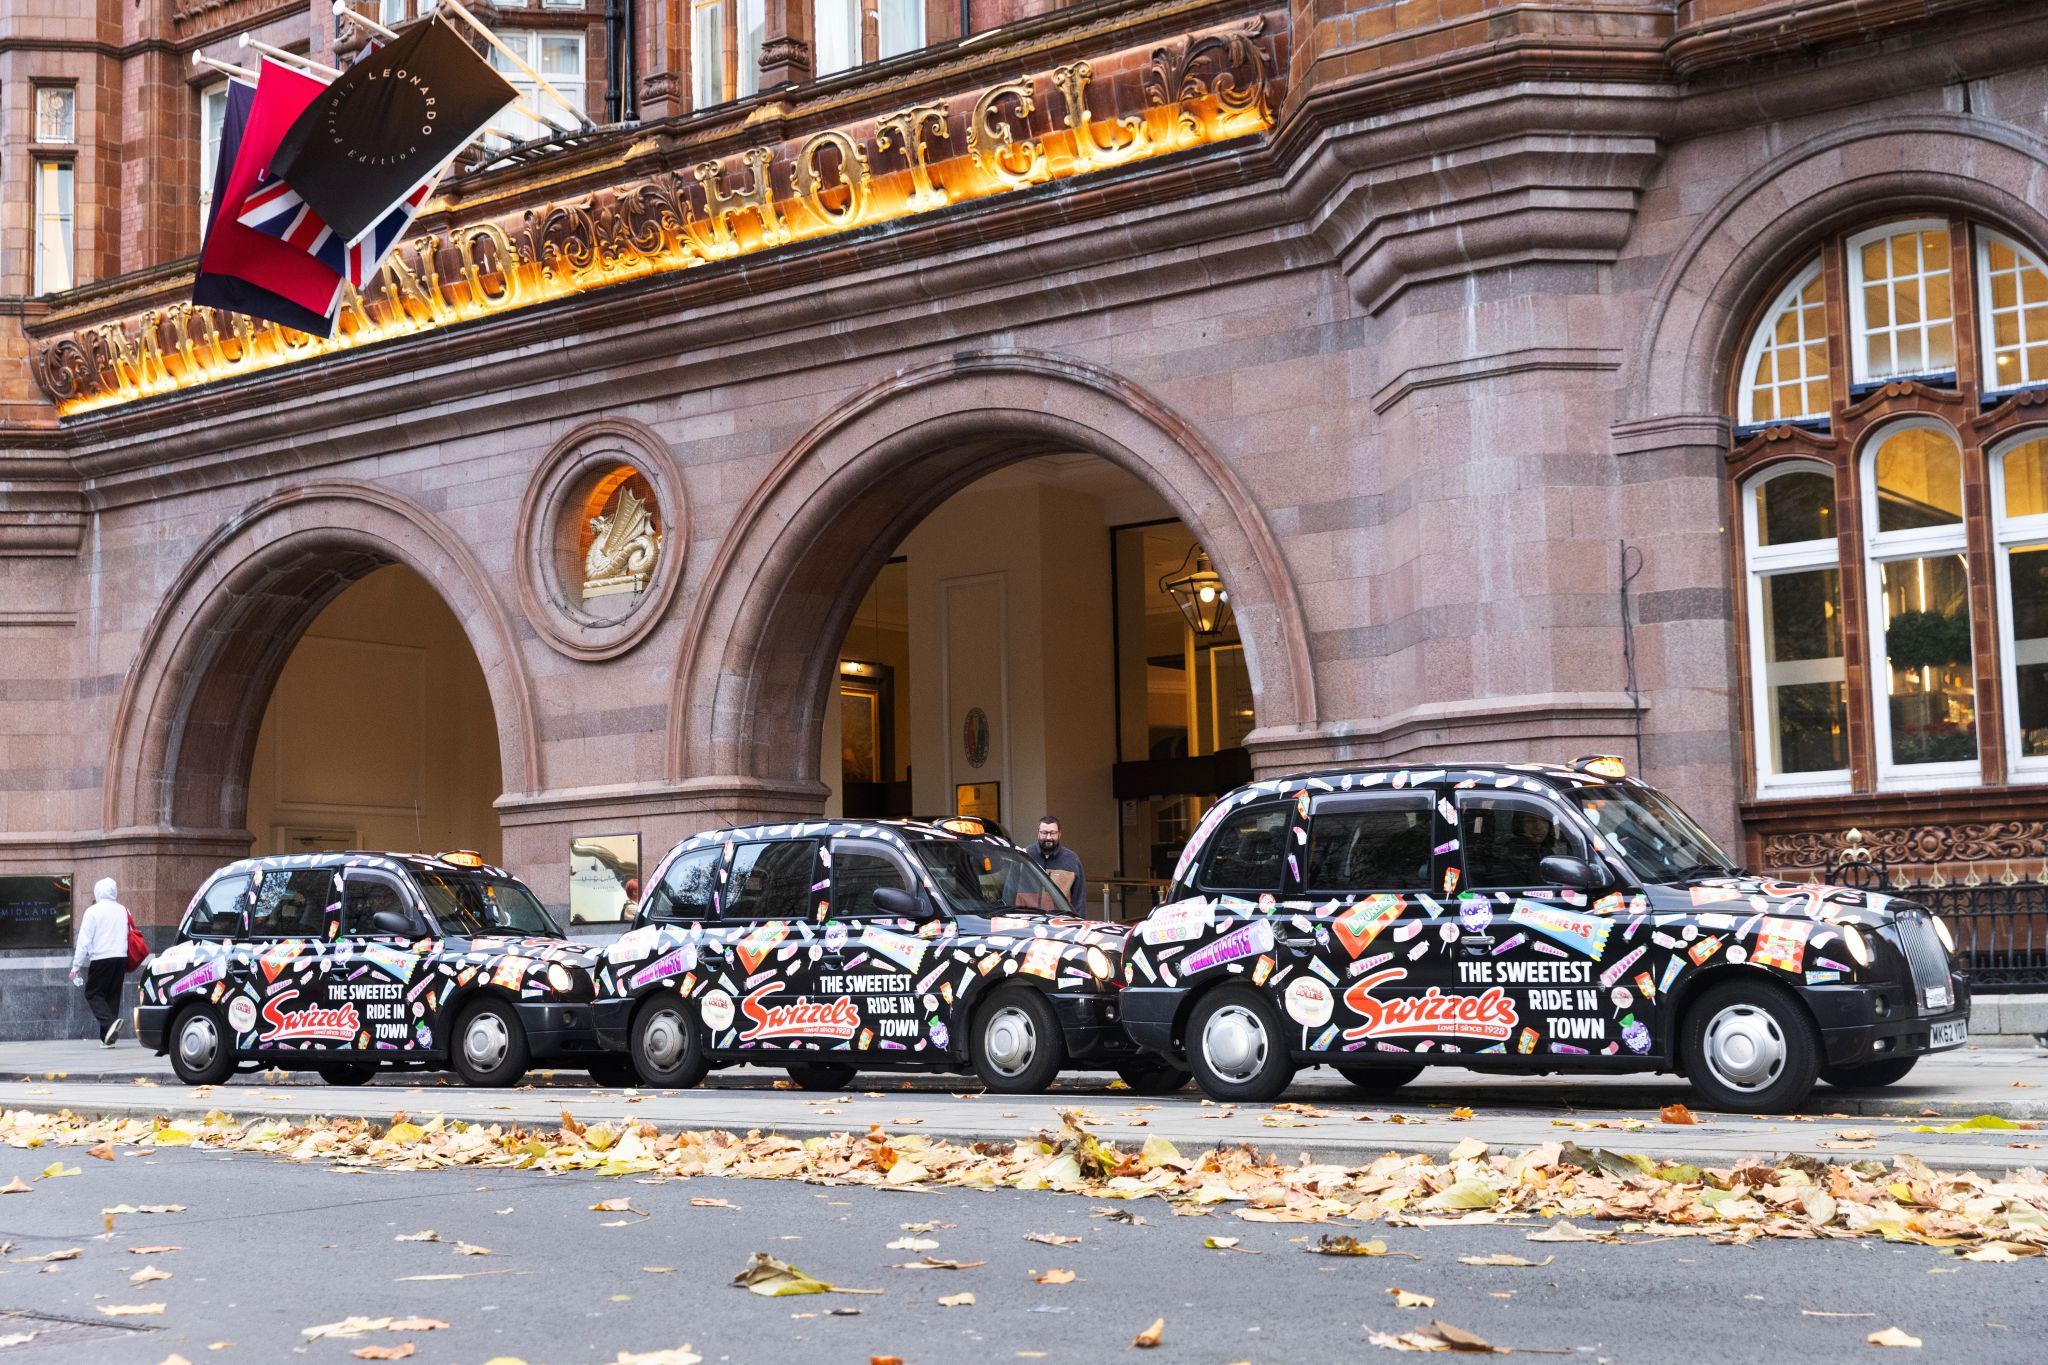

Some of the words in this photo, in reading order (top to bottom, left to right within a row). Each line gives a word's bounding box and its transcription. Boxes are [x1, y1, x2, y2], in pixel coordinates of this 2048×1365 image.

[369, 69, 437, 135] LEONARDO
[329, 83, 355, 144] Limited
[347, 146, 417, 165] Edition
[693, 58, 1154, 258] HOTEL
[956, 821, 982, 834] TAXI
[1, 908, 57, 916] MIDLAND
[1520, 907, 1592, 938] REFRESHERS
[1189, 949, 1213, 972] PARMA
[1213, 927, 1251, 962] VIOLETS
[1458, 962, 1492, 982] THE
[1496, 961, 1592, 982] SWEETEST
[328, 985, 348, 1000] THE
[349, 984, 403, 1000] SWEETEST
[820, 976, 843, 993] THE
[846, 974, 911, 992] SWEETEST
[867, 997, 898, 1014] RIDE
[901, 997, 914, 1013] IN
[1344, 968, 1518, 1040] Swizzels
[1528, 990, 1573, 1010] RIDE
[1577, 989, 1598, 1010] IN
[260, 990, 360, 1041] Swizzels
[366, 1004, 391, 1019] RIDE
[394, 1004, 405, 1019] IN
[740, 981, 860, 1041] Swizzels
[375, 1024, 408, 1039] TOWN
[879, 1020, 918, 1036] TOWN
[1460, 1025, 1483, 1033] since
[1484, 1026, 1505, 1035] 1928
[1547, 1018, 1605, 1039] TOWN
[1933, 1023, 1953, 1045] MK62
